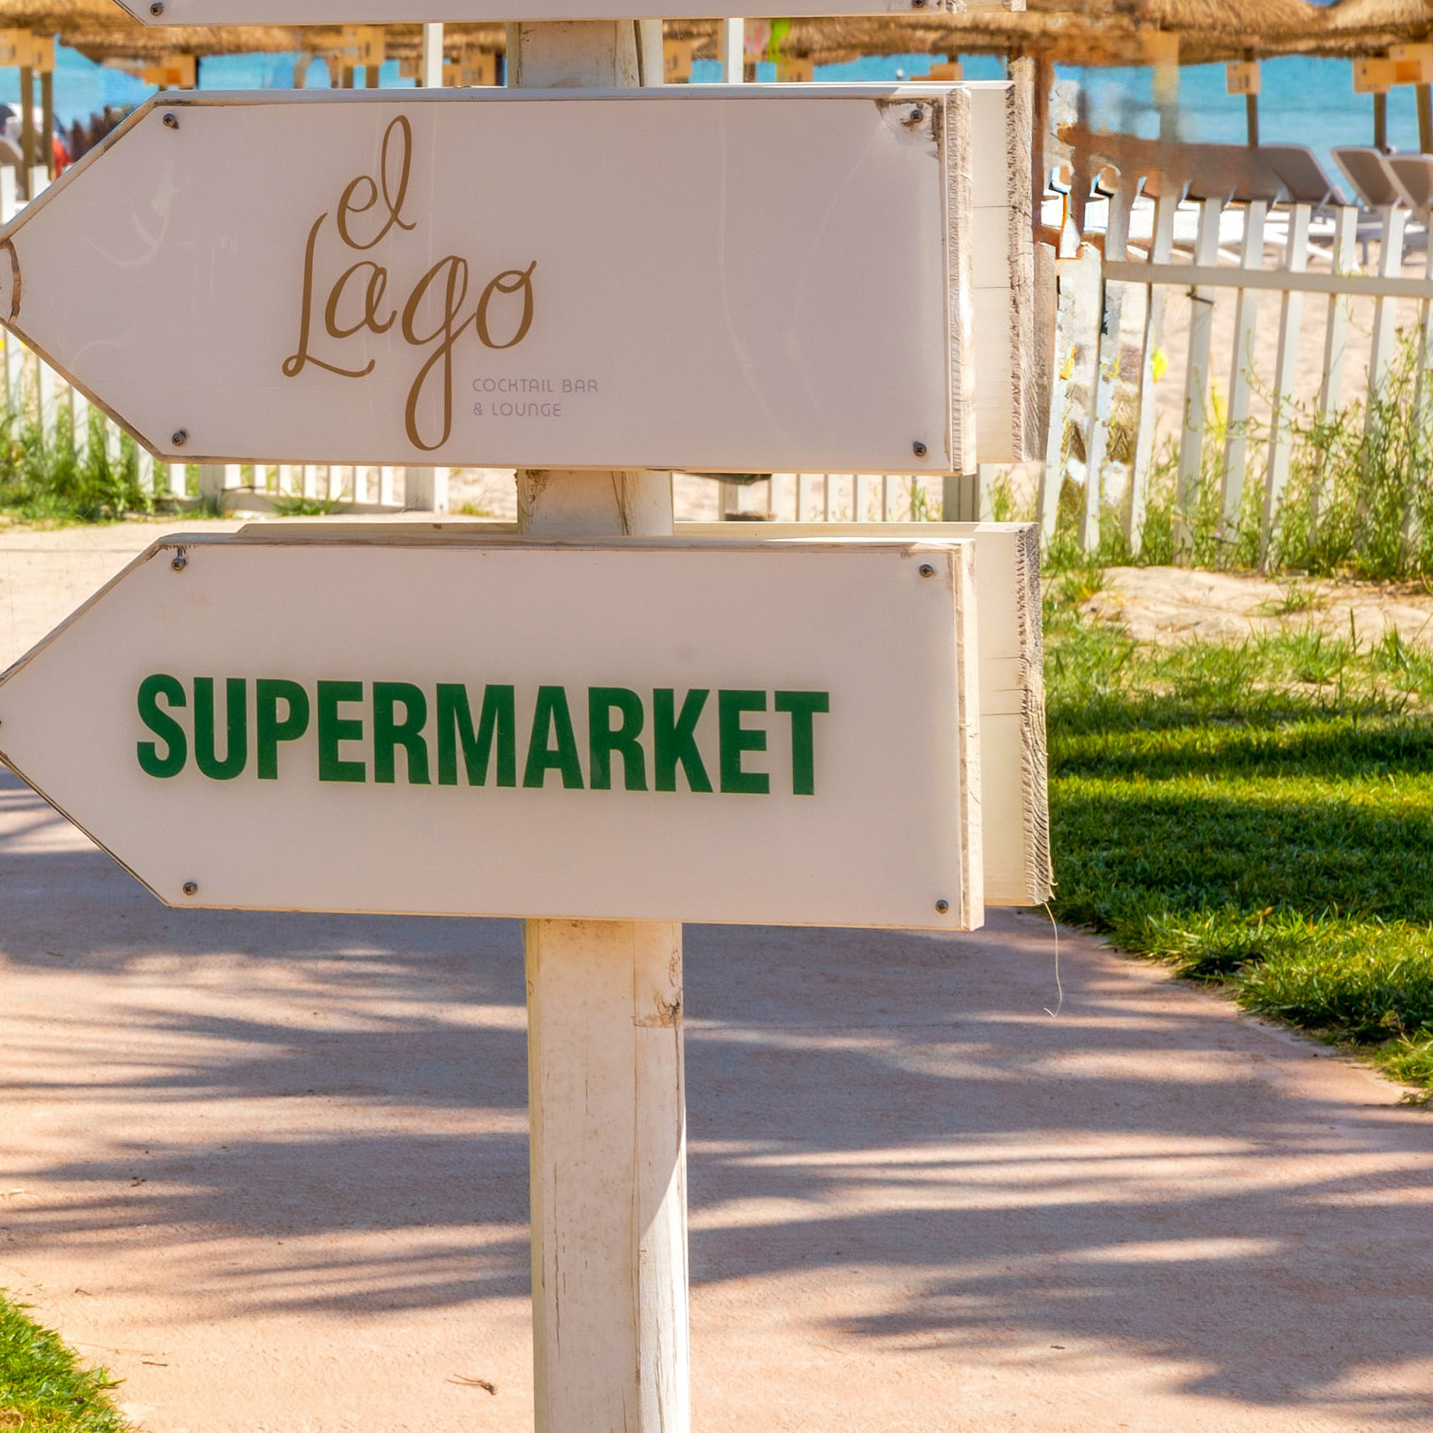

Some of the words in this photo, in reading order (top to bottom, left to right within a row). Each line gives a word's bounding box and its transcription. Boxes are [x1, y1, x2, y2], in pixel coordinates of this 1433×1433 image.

[337, 115, 417, 250] el
[282, 212, 537, 451] Lago
[472, 378, 554, 393] COCKTAIL
[562, 378, 598, 393] BAR
[473, 402, 483, 416] &
[492, 402, 562, 417] LOUNGE
[136, 672, 830, 796] SUPERMARKET
